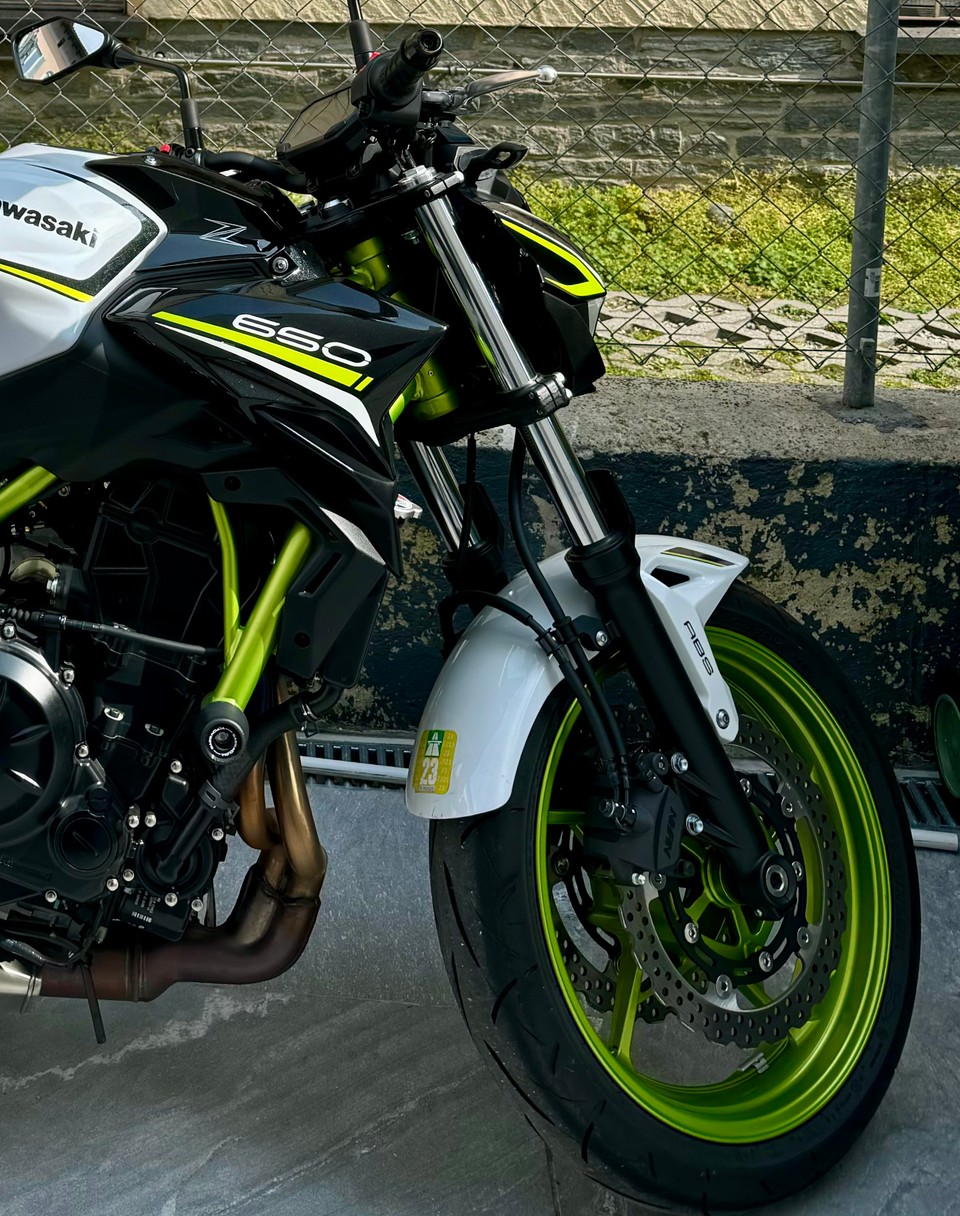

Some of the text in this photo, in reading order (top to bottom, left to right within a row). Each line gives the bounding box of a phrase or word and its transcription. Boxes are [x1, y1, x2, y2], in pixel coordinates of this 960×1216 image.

[232, 313, 372, 367] 650
[683, 620, 715, 676] ABS
[420, 757, 439, 785] 23
